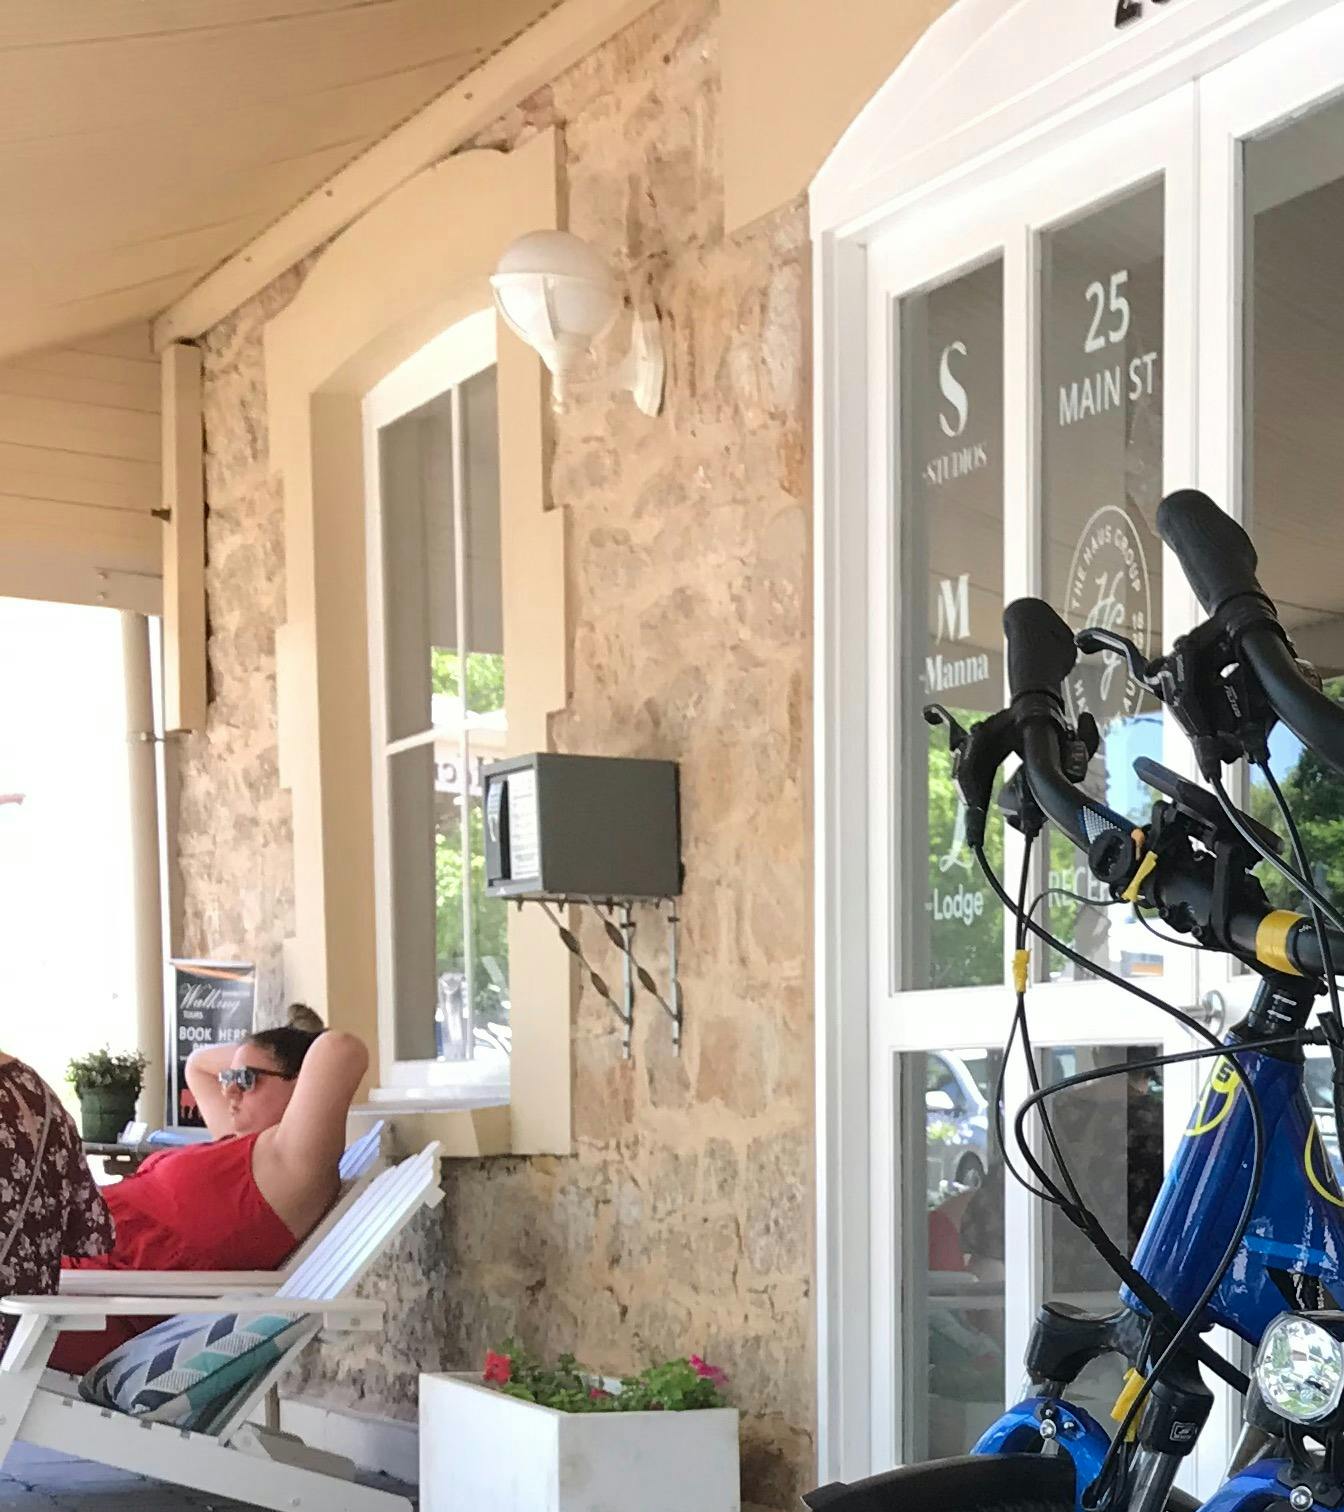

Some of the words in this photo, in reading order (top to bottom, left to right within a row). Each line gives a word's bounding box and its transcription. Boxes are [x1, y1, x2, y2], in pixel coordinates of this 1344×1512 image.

[1084, 268, 1130, 353] 25
[939, 341, 968, 437] S
[1059, 366, 1121, 426] MAIN
[1128, 351, 1158, 401] ST
[1072, 566, 1088, 609] THE
[1083, 525, 1112, 567] HAUS
[1114, 529, 1141, 592] GROUP
[936, 573, 971, 646] M
[924, 653, 990, 694] Manna
[933, 884, 984, 925] Lodge
[180, 983, 241, 1017] Walking
[179, 1026, 212, 1041] BOOK
[1218, 1065, 1236, 1083] 5
